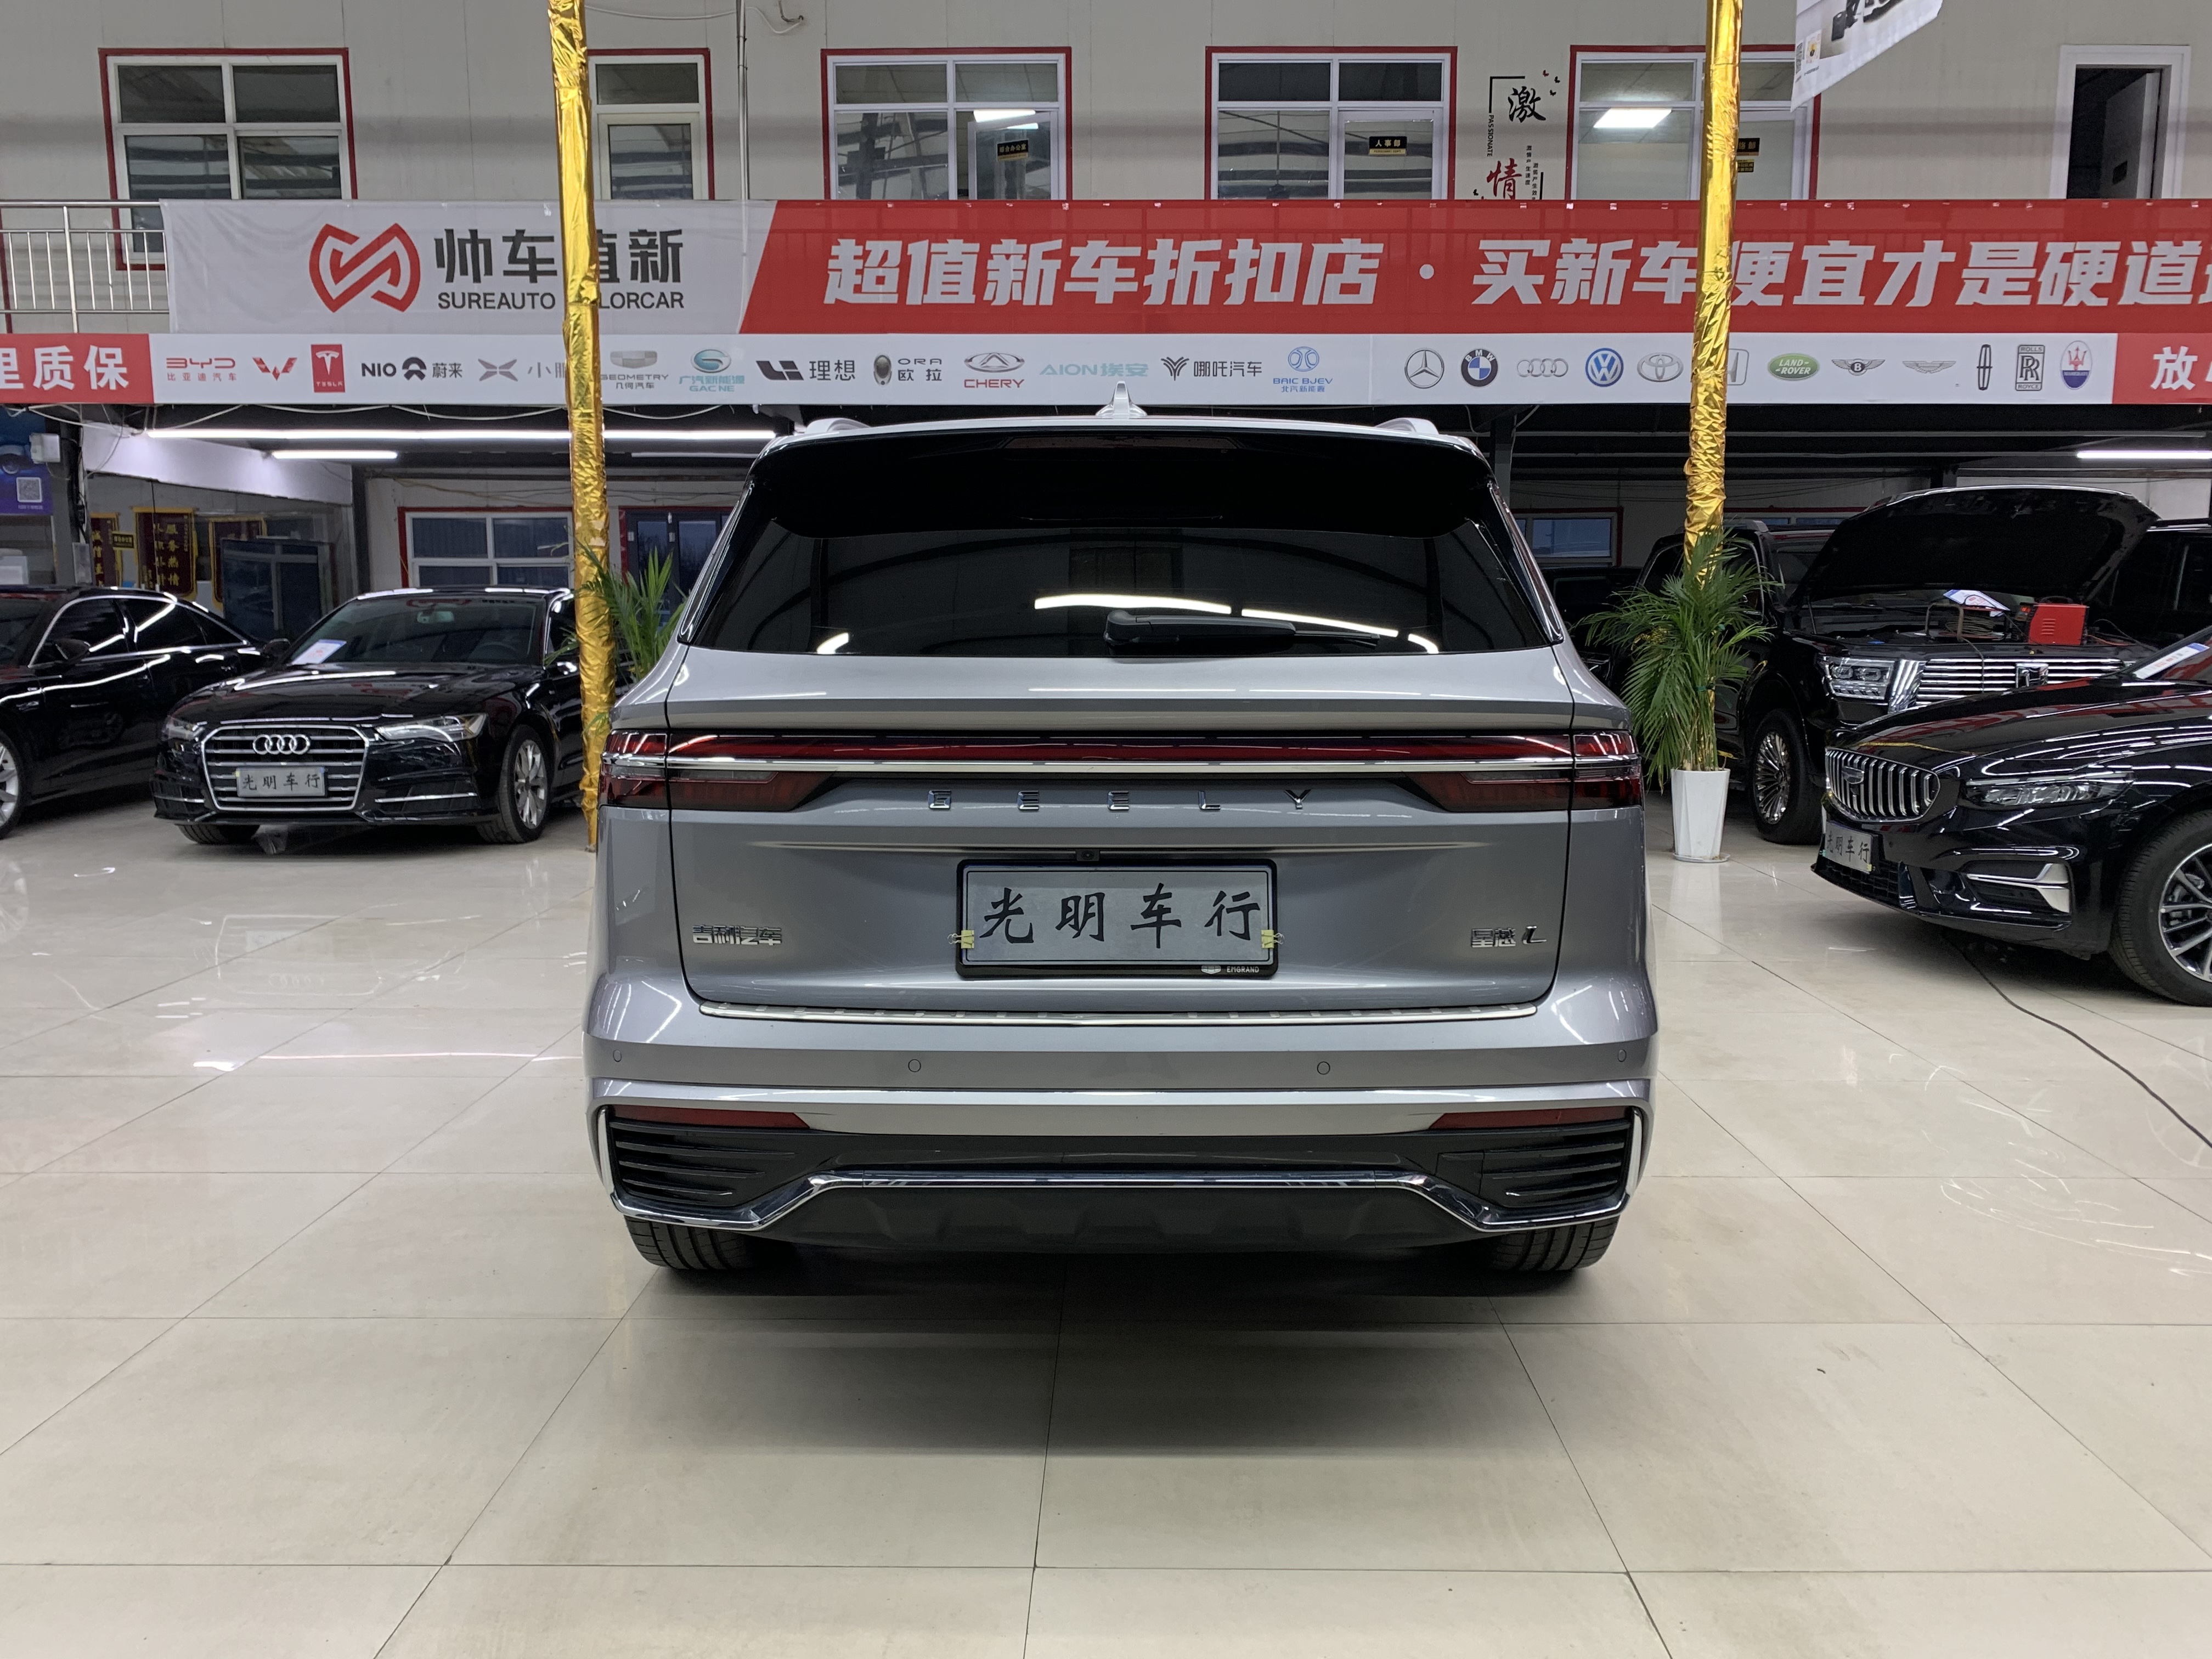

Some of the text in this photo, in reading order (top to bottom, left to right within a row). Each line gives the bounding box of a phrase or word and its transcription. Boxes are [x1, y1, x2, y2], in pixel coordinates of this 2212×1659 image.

[823, 238, 1384, 306] 超值新车折扣店
[438, 291, 684, 310] SUREAUTO LORCAR
[166, 358, 235, 369] BYD
[1464, 349, 1495, 363] BMW
[167, 373, 236, 381] 比亚迪汽车
[361, 363, 397, 377] NIO
[432, 362, 463, 379] 蔚来
[809, 359, 856, 381] 理想
[898, 369, 942, 381] 欧拉
[1193, 361, 1262, 377] 哪吒汽车
[679, 375, 744, 385] 广汽新能源
[964, 379, 1025, 388] CHERY
[242, 772, 320, 791] 光明车行
[927, 789, 1311, 811] GEELY
[979, 883, 1261, 949] 光明车行
